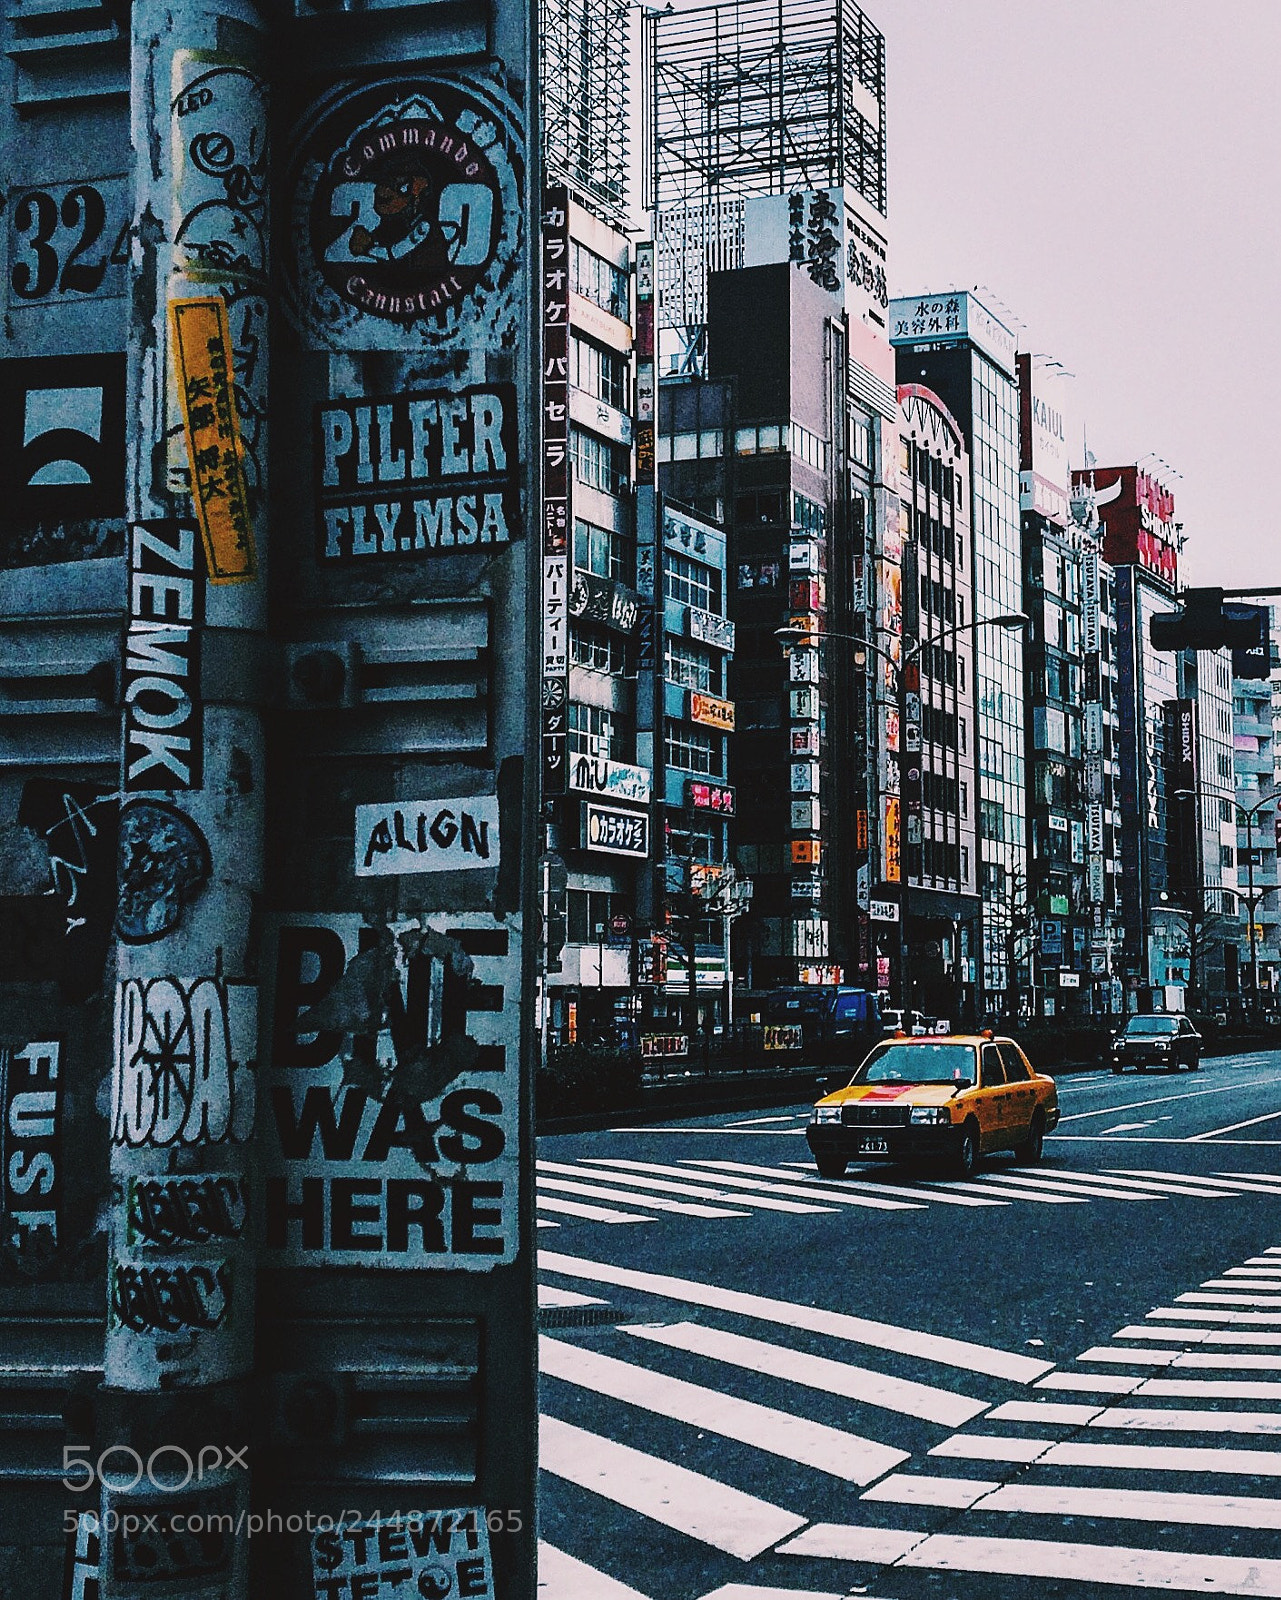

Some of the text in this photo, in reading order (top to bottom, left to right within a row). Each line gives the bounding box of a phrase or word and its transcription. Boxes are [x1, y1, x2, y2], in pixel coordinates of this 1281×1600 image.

[545, 206, 566, 321] カラオケ
[894, 315, 961, 337] 美容外科
[915, 299, 961, 319] 水の森
[321, 393, 507, 487] PILFER
[545, 356, 566, 467] パセラ
[1032, 395, 1064, 442] KAIUL
[323, 493, 510, 558] FLY.MSA
[546, 563, 564, 650] パーティー
[1085, 556, 1095, 599] TSUTAYA
[126, 525, 195, 786] ZEMOK
[1087, 606, 1097, 649] TSUTAYA
[1181, 712, 1192, 762] SHIDAX
[364, 808, 490, 868] ALIGN
[600, 814, 633, 846] カラオケ
[1091, 803, 1101, 850] TSUTAYA
[271, 1084, 506, 1164] WAS
[267, 1178, 505, 1255] HERE
